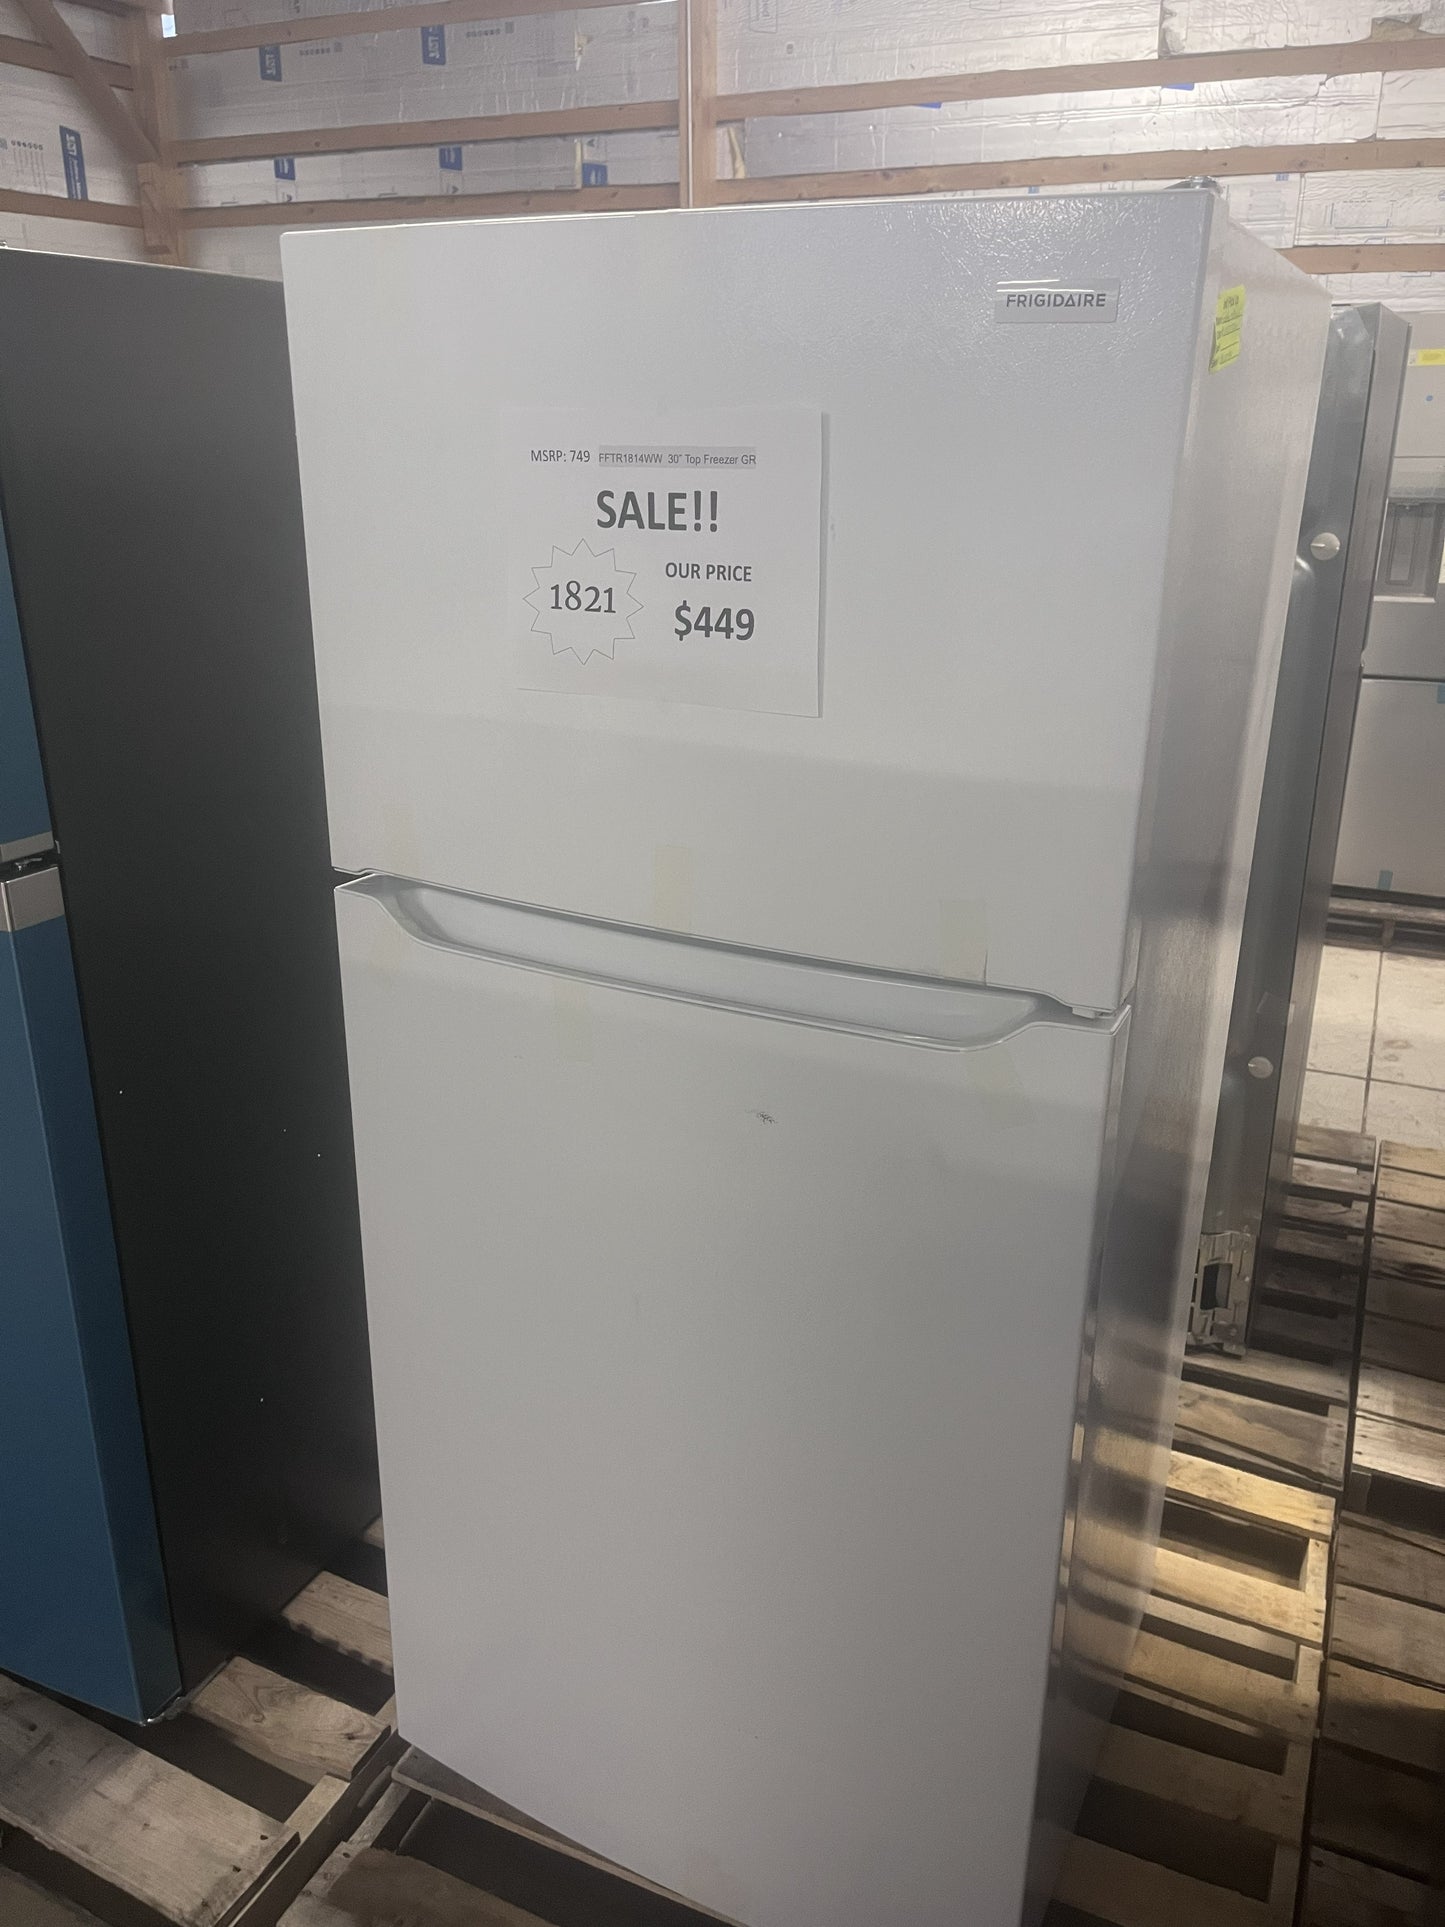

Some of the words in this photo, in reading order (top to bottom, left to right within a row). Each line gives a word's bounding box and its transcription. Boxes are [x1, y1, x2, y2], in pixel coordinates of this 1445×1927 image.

[1006, 293, 1106, 308] FRIGIDAIRE
[531, 450, 567, 462] MSRP:
[569, 451, 590, 462] 749
[599, 452, 662, 464] FFTR1814WW
[685, 454, 701, 466] Top
[704, 454, 738, 465] Freezer
[741, 454, 756, 465] GR
[597, 490, 718, 532] SALE!!
[665, 562, 700, 579] OUR
[706, 565, 752, 582] PRICE
[550, 580, 616, 613] 1821
[674, 600, 755, 641] $449
